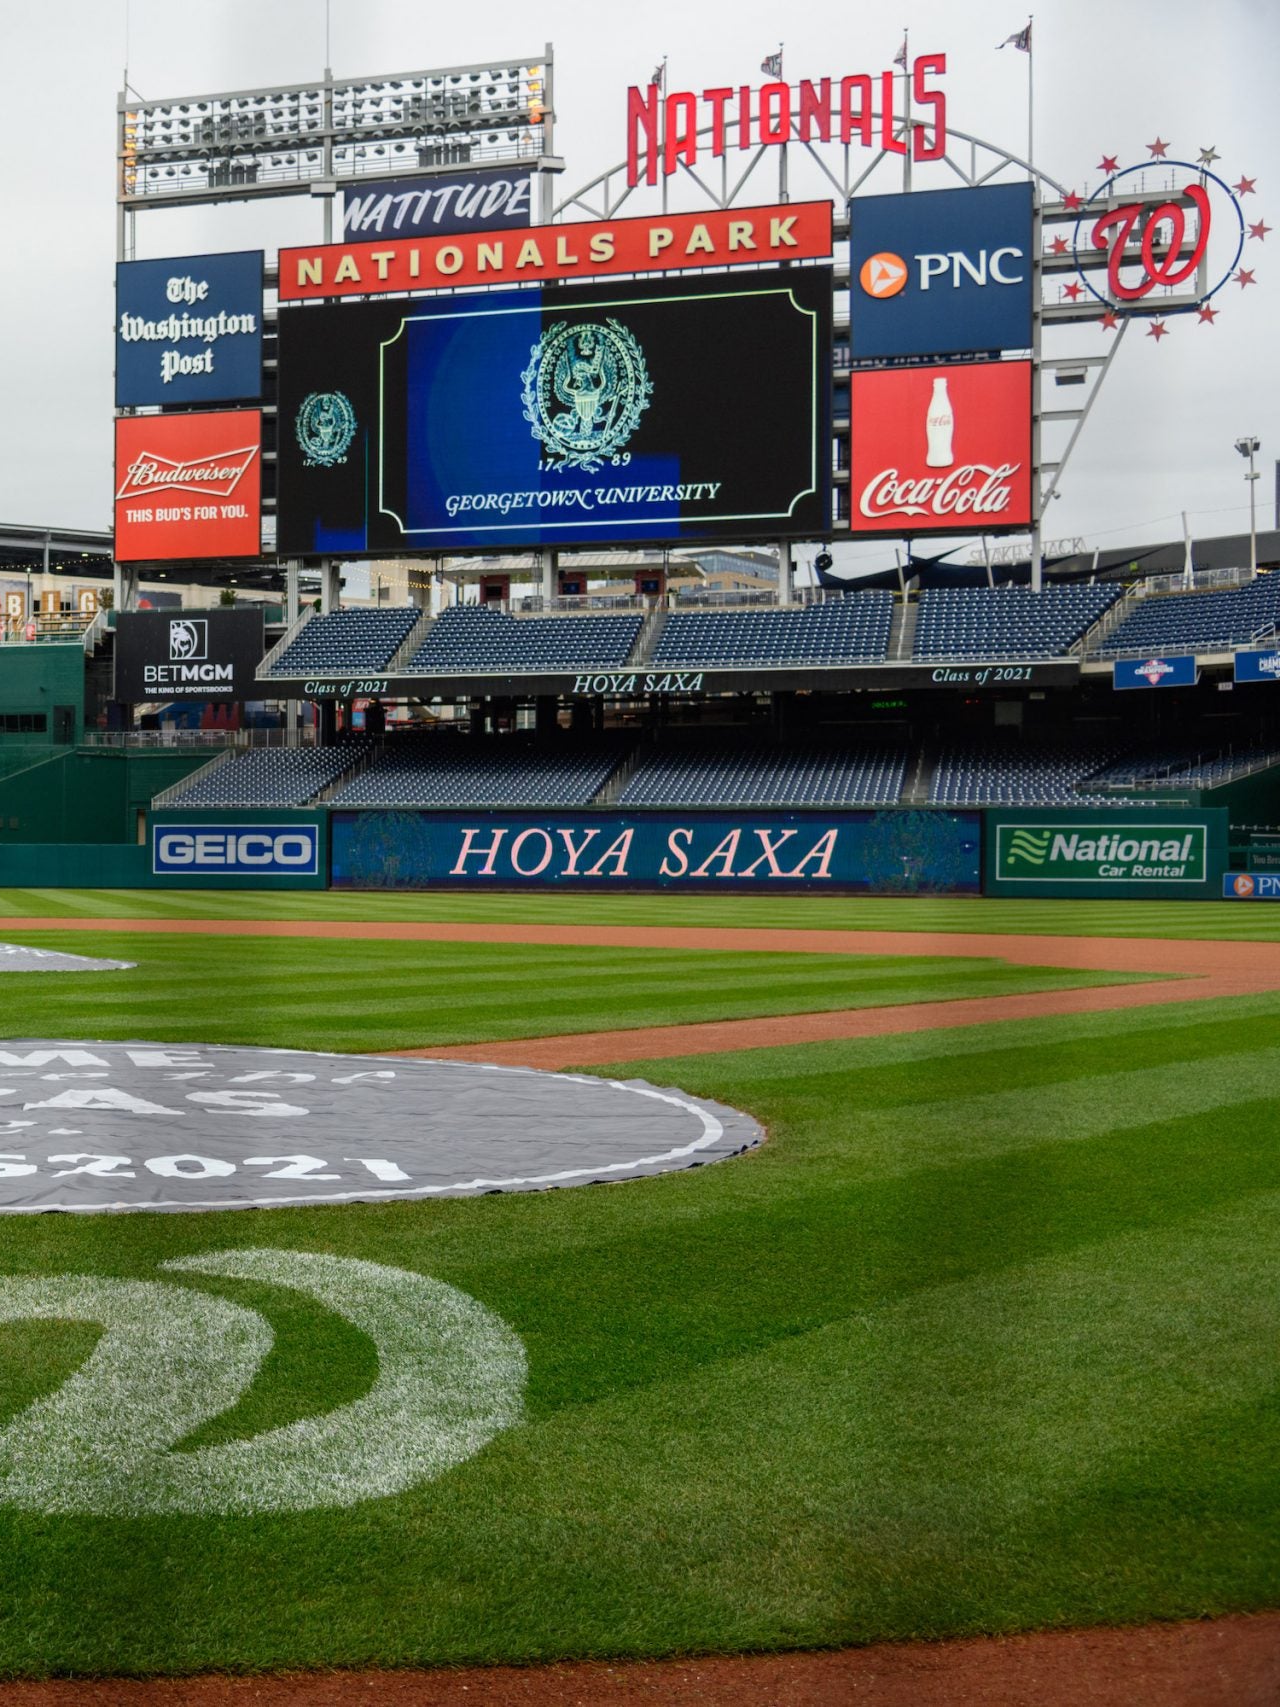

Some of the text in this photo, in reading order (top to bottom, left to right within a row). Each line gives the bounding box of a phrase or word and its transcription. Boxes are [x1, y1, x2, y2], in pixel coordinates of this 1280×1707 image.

[626, 53, 947, 188] NATIONALS
[344, 178, 531, 232] NATITUDE
[296, 217, 799, 287] NATIONALS PARK
[914, 247, 1023, 290] PNC
[166, 276, 210, 305] The
[120, 310, 257, 343] Washington
[160, 347, 214, 384] Post
[128, 462, 244, 487] Budweiser
[445, 483, 721, 517] GEORGETOWN UNIVERSITY
[860, 463, 1022, 519] Coca-Cola
[126, 505, 249, 523] THIS BUD'S FOR YOU.
[144, 664, 234, 682] BETMGM
[572, 673, 704, 693] HOYA SAXA
[932, 667, 1032, 686] Class of 2021
[144, 687, 158, 695] THE
[158, 687, 174, 695] KING
[185, 685, 233, 694] SPORTSBOOKS
[304, 680, 388, 697] Class of 2021
[159, 834, 312, 865] GEICO
[449, 827, 839, 878] HOYA SAXA
[1050, 834, 1194, 861] National
[1098, 864, 1186, 877] Car Rental
